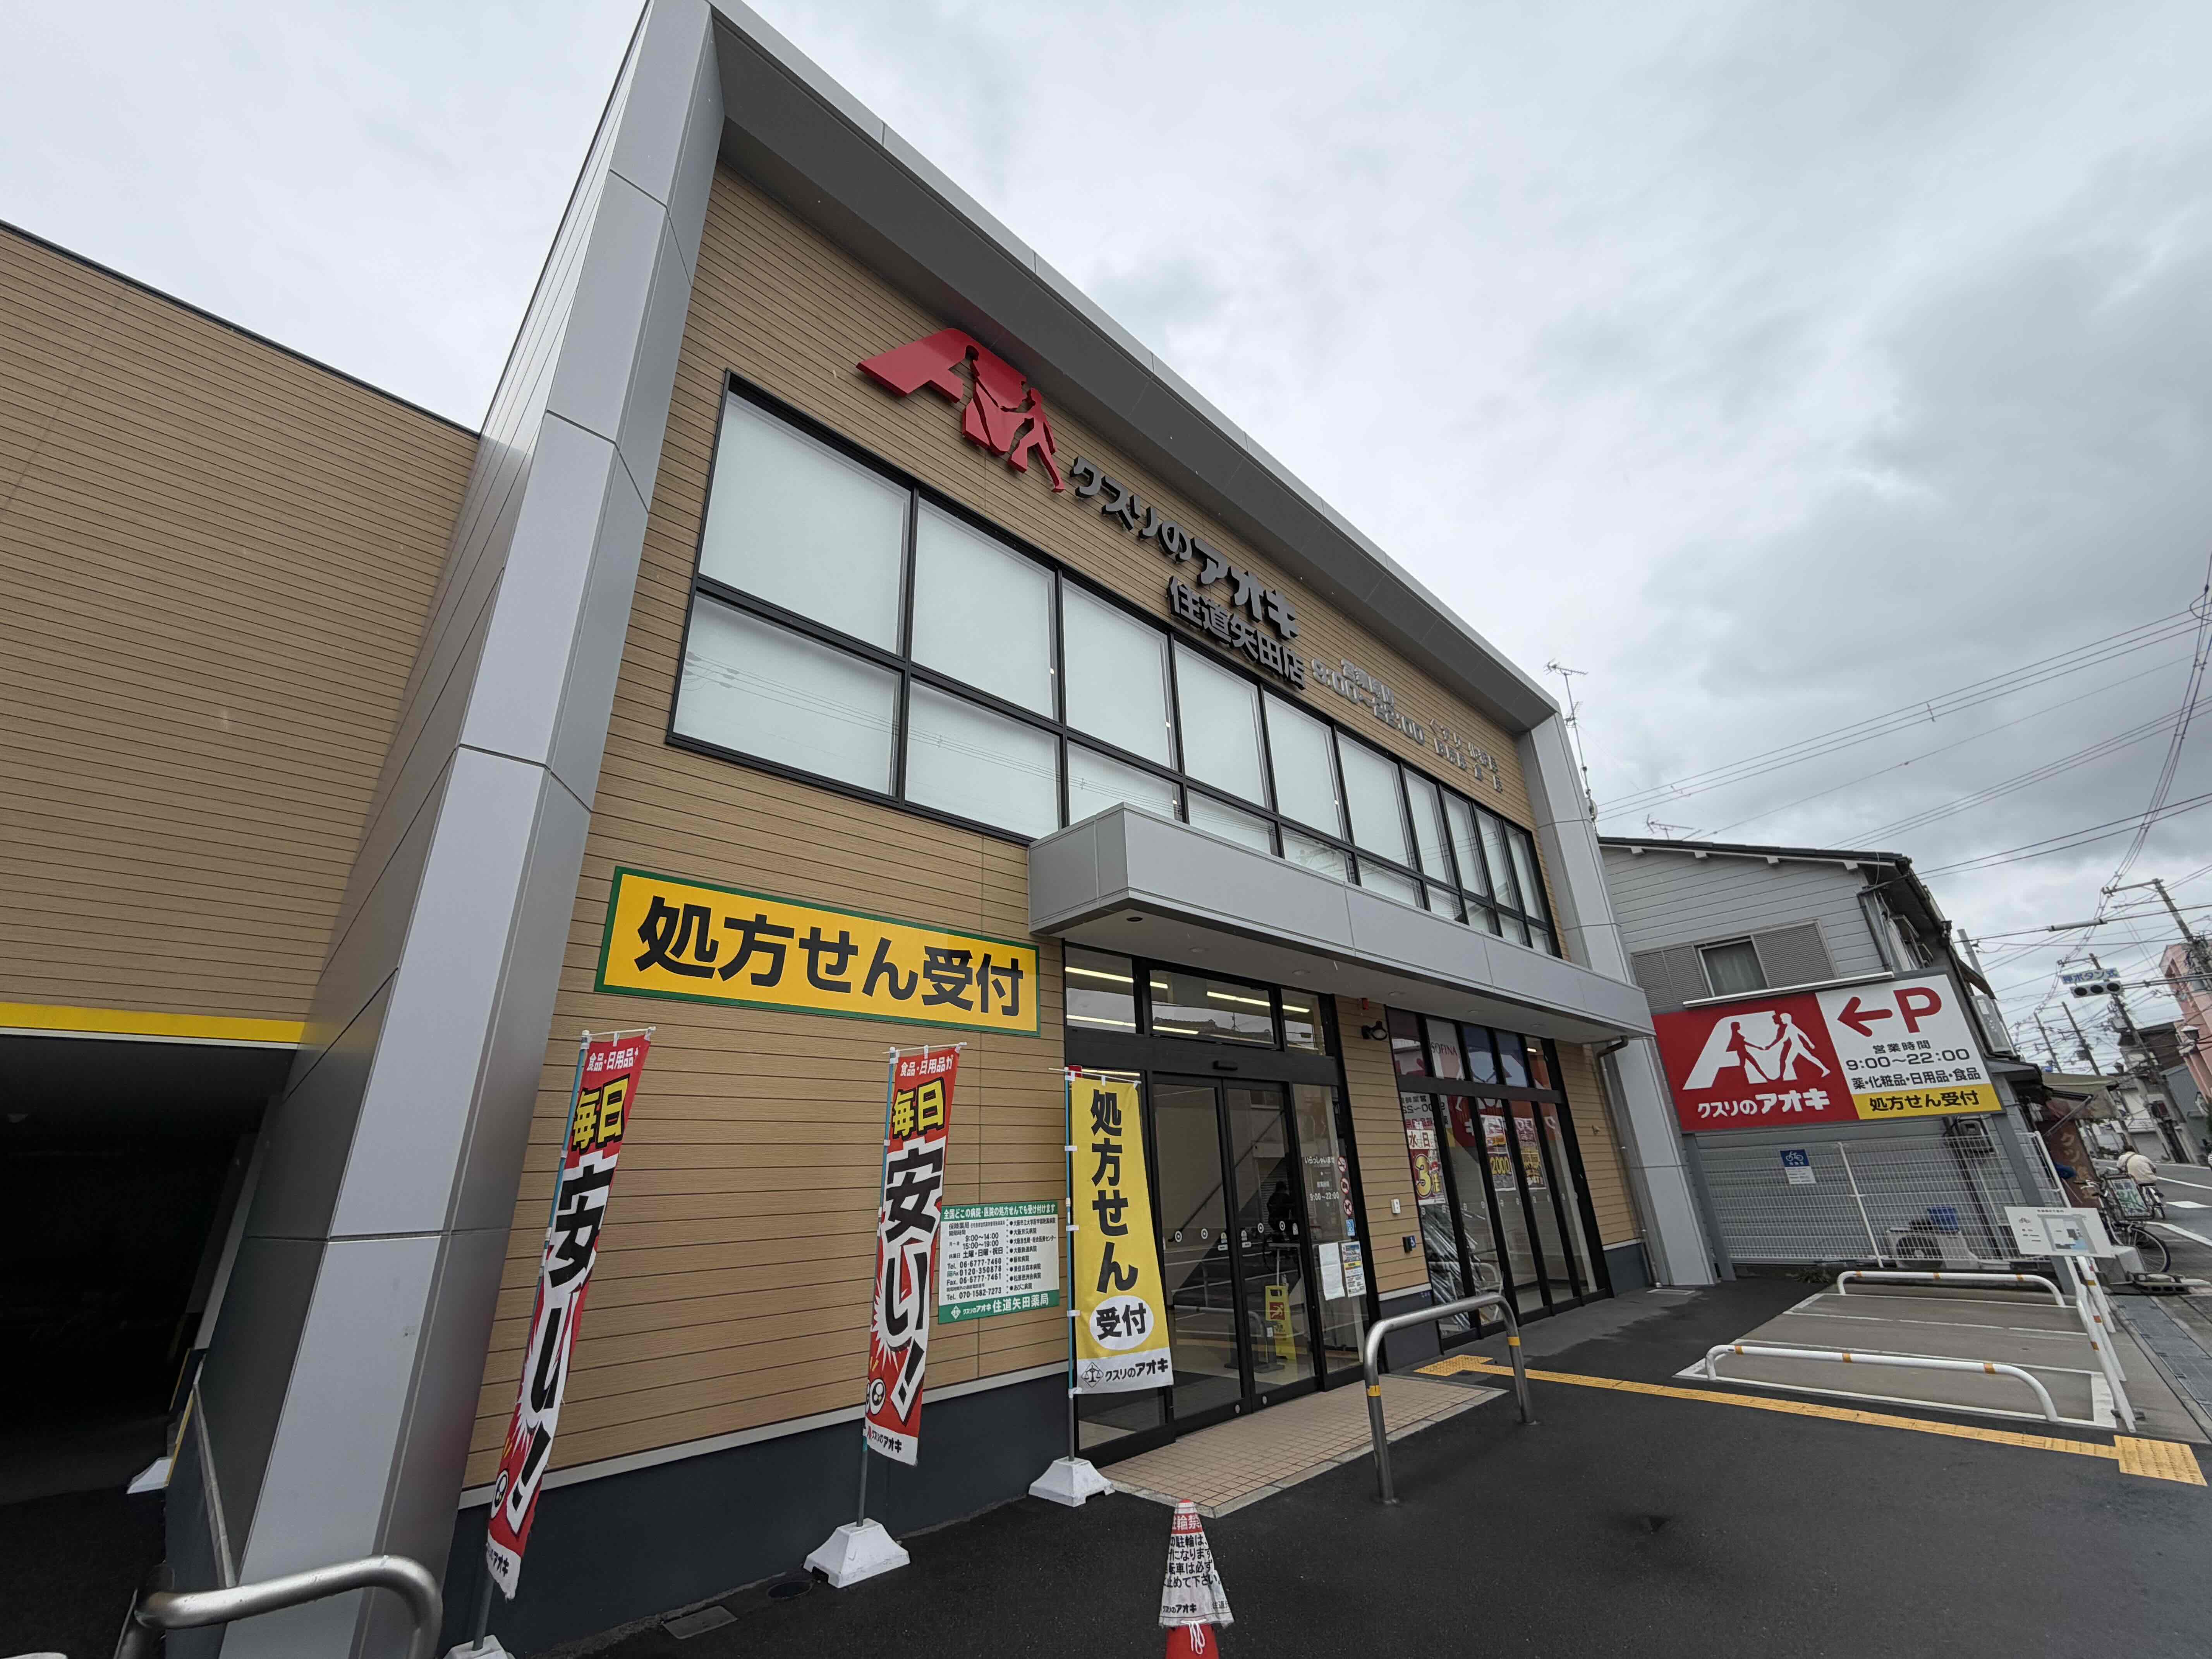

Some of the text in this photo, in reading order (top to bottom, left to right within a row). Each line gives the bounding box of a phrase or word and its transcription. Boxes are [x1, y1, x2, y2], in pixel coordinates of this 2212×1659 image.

[1070, 456, 1299, 639] クスリのアオキ
[1166, 575, 1306, 689] 住道矢田店
[634, 895, 1024, 1017] 処方せん受付
[2063, 969, 2119, 983] 押ボタン式
[1893, 987, 1942, 1033] P
[1431, 1042, 1457, 1056] SOFINA
[1846, 1049, 1970, 1070] 9:00～22:00
[1872, 1040, 1931, 1054] 営業時間
[572, 1076, 629, 1150] 毎日
[893, 1078, 945, 1139] 毎日
[1698, 1088, 1830, 1118] クスリのアオキ
[1870, 1090, 1980, 1111] 処方せん受付
[1091, 1089, 1139, 1293] 処方せん
[993, 1293, 1049, 1313] 住道矢田薬局
[1096, 1303, 1147, 1340] 受付
[1105, 1358, 1168, 1382] クスリのアオキ
